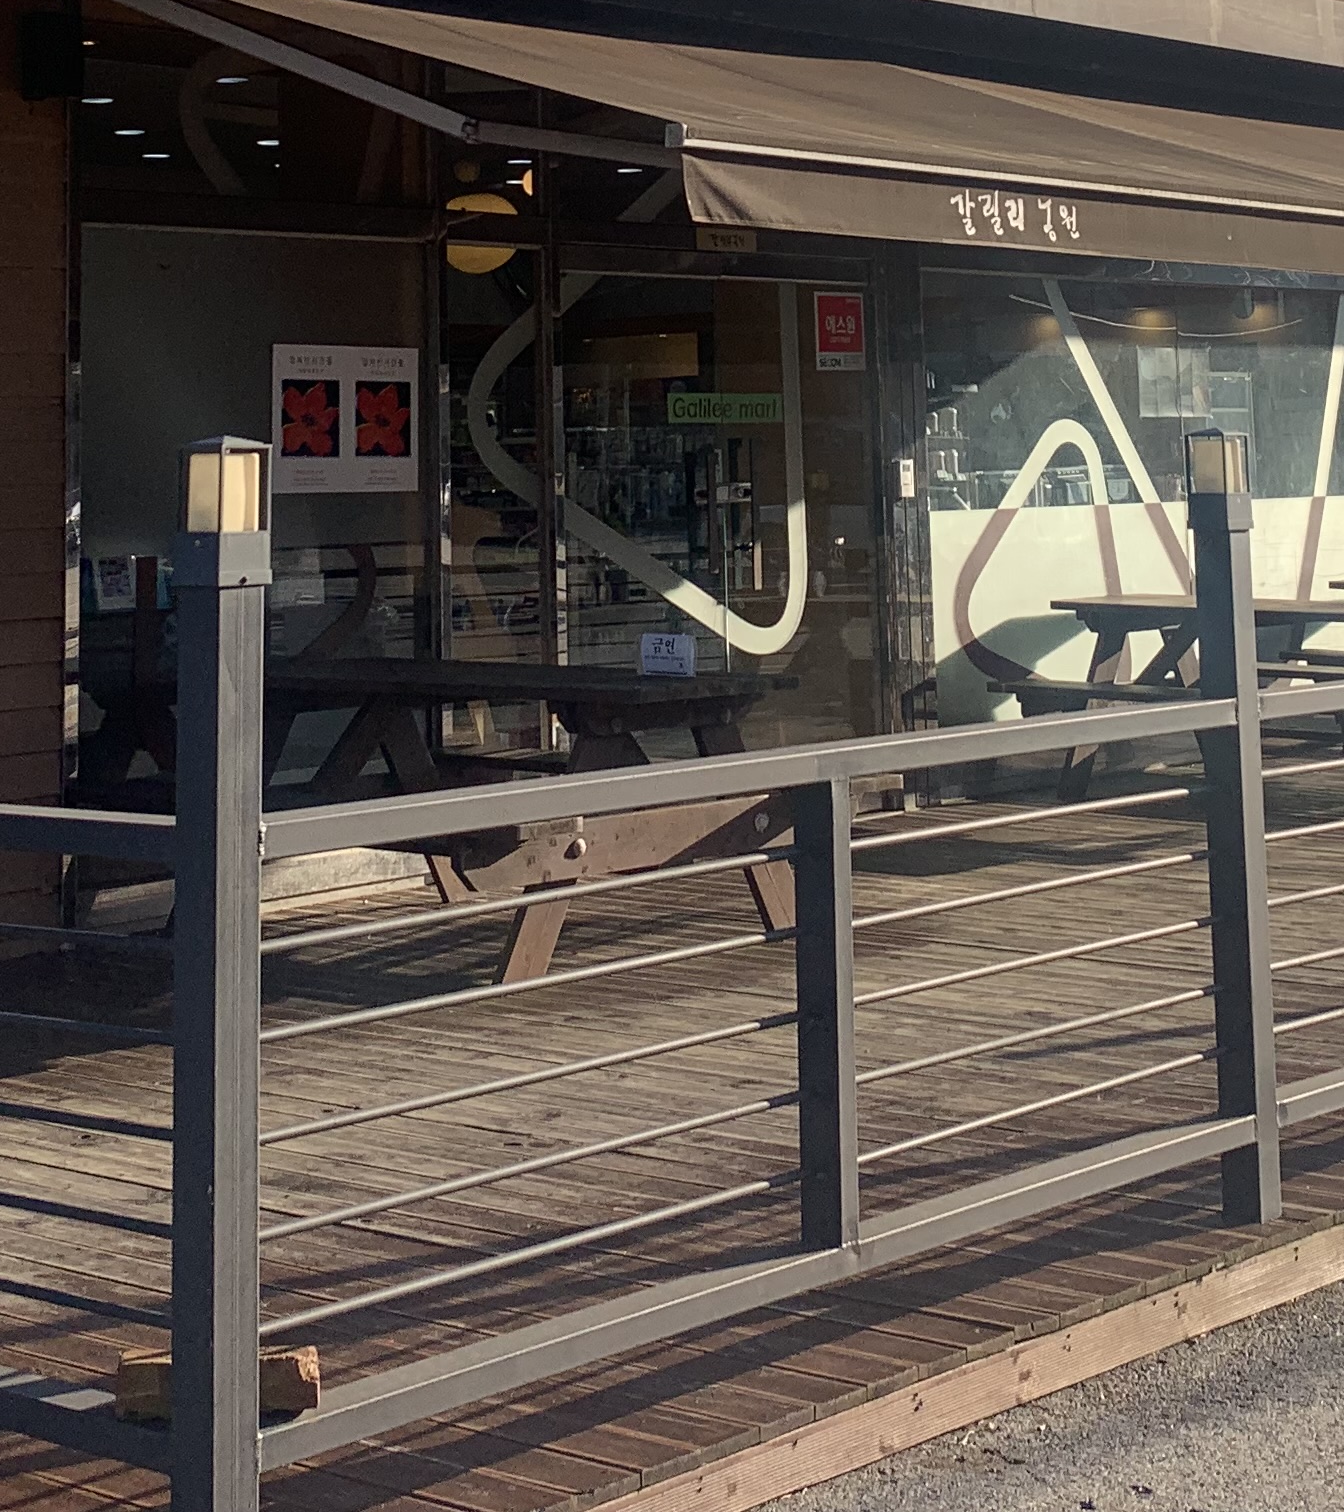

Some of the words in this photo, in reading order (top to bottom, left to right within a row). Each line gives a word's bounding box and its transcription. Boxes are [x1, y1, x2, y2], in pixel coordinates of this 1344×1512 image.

[825, 315, 856, 335] 에스원
[672, 397, 733, 419] Galilee
[739, 399, 777, 419] mart
[651, 637, 676, 655] 금연
